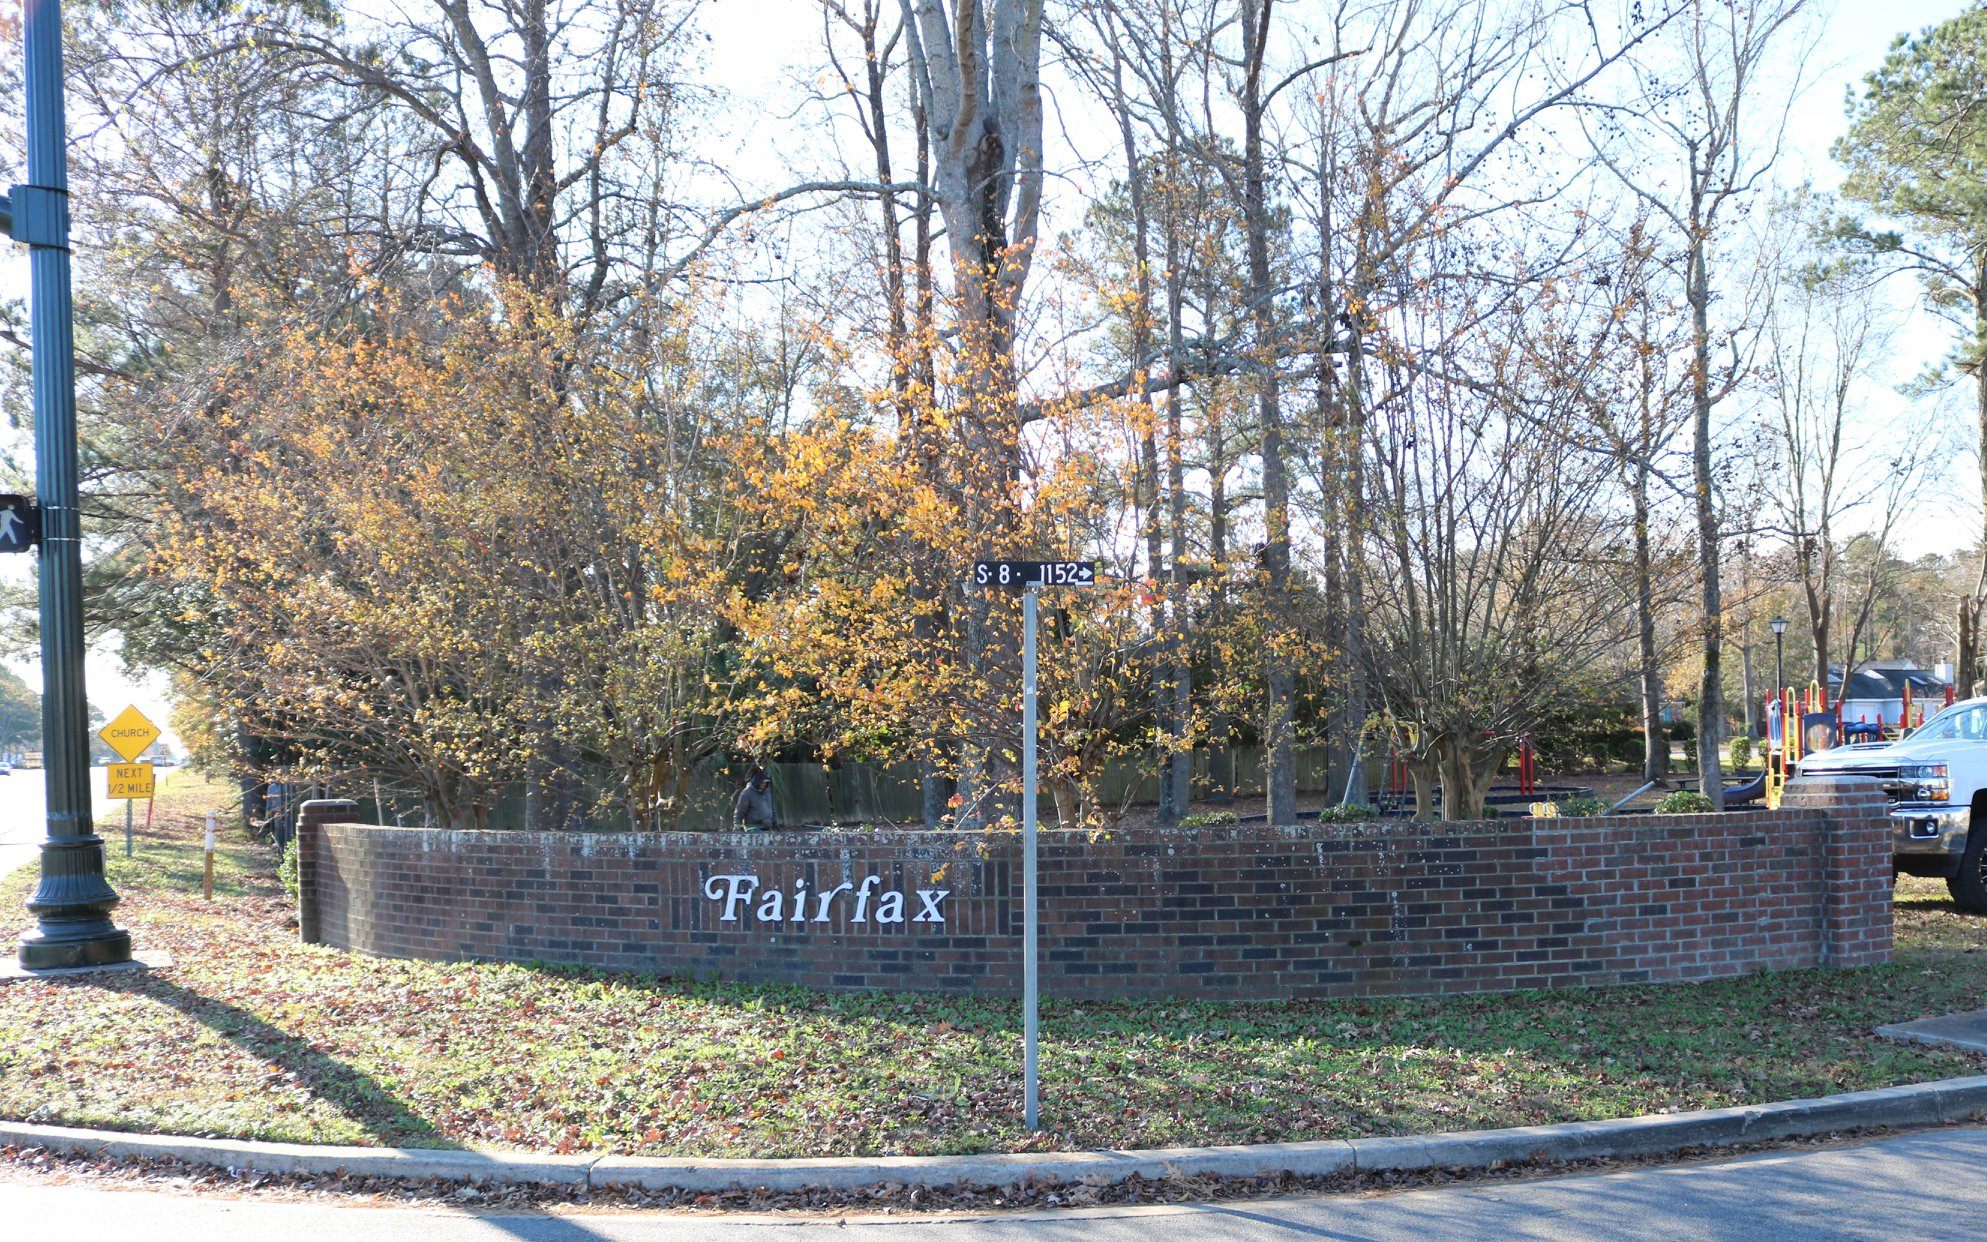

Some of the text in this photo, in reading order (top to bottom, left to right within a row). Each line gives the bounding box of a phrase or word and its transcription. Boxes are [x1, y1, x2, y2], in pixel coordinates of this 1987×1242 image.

[1040, 562, 1079, 584] 1152
[111, 729, 150, 738] CHURCH
[117, 768, 143, 779] NEXT
[108, 782, 151, 794] 1/2 MILE
[704, 874, 950, 924] Fairfax
